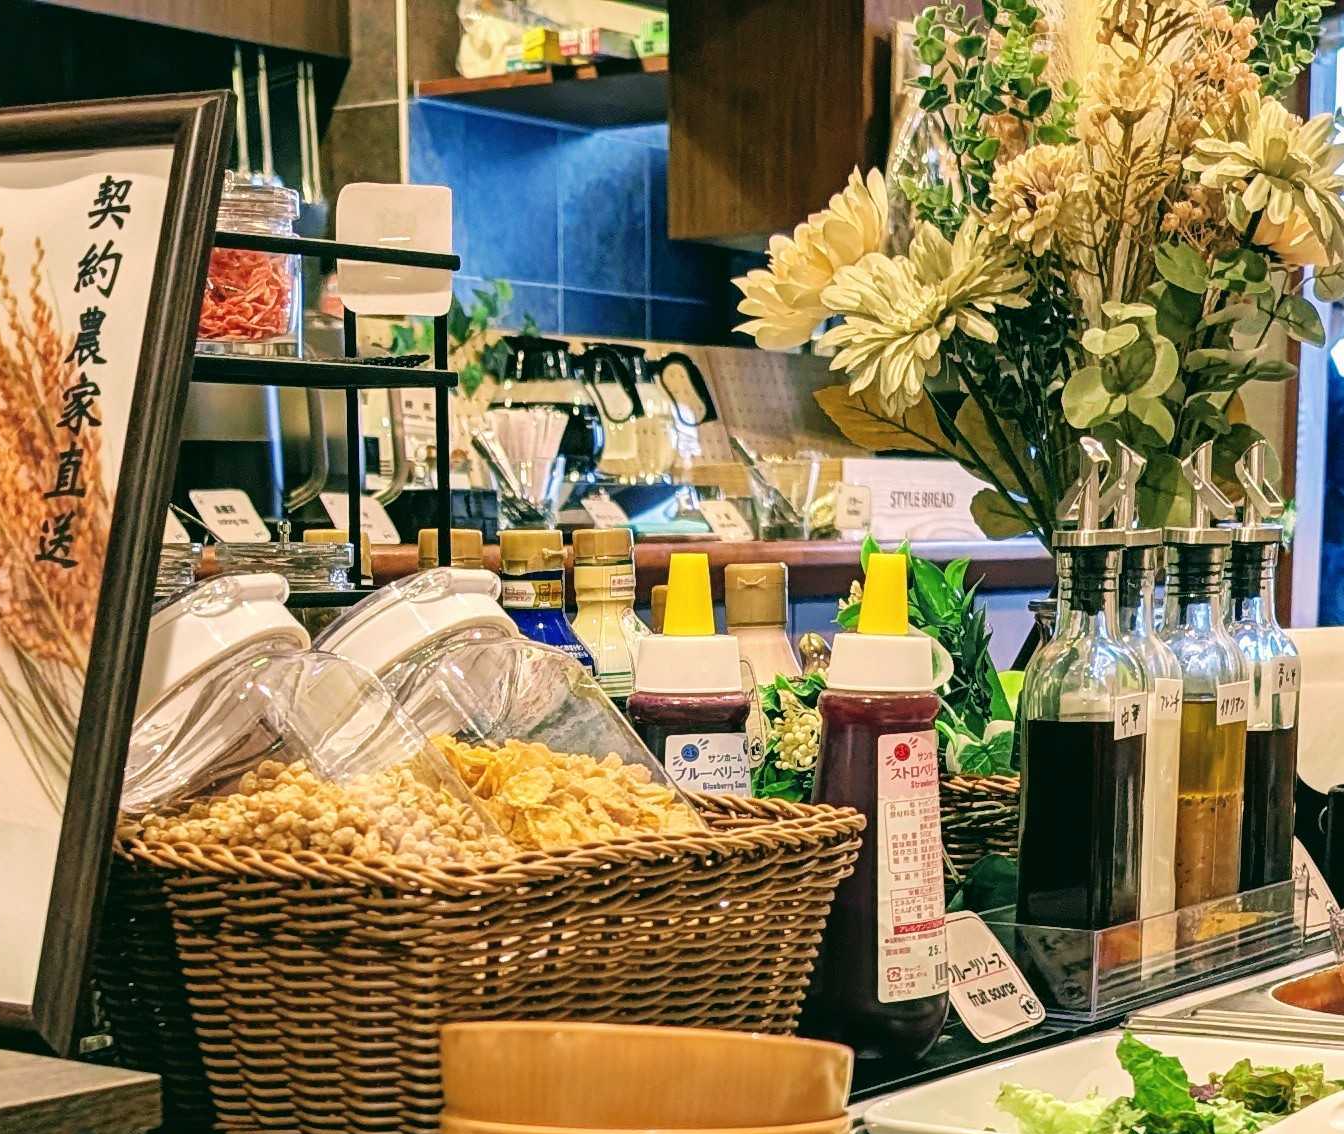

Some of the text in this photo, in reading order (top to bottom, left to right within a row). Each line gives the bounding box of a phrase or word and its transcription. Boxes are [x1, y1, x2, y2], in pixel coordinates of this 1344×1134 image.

[34, 174, 132, 569] 契約農家直送
[890, 490, 955, 508] STYLE BREAD
[1120, 703, 1141, 736] 中華
[967, 981, 1018, 1008] fruit source
